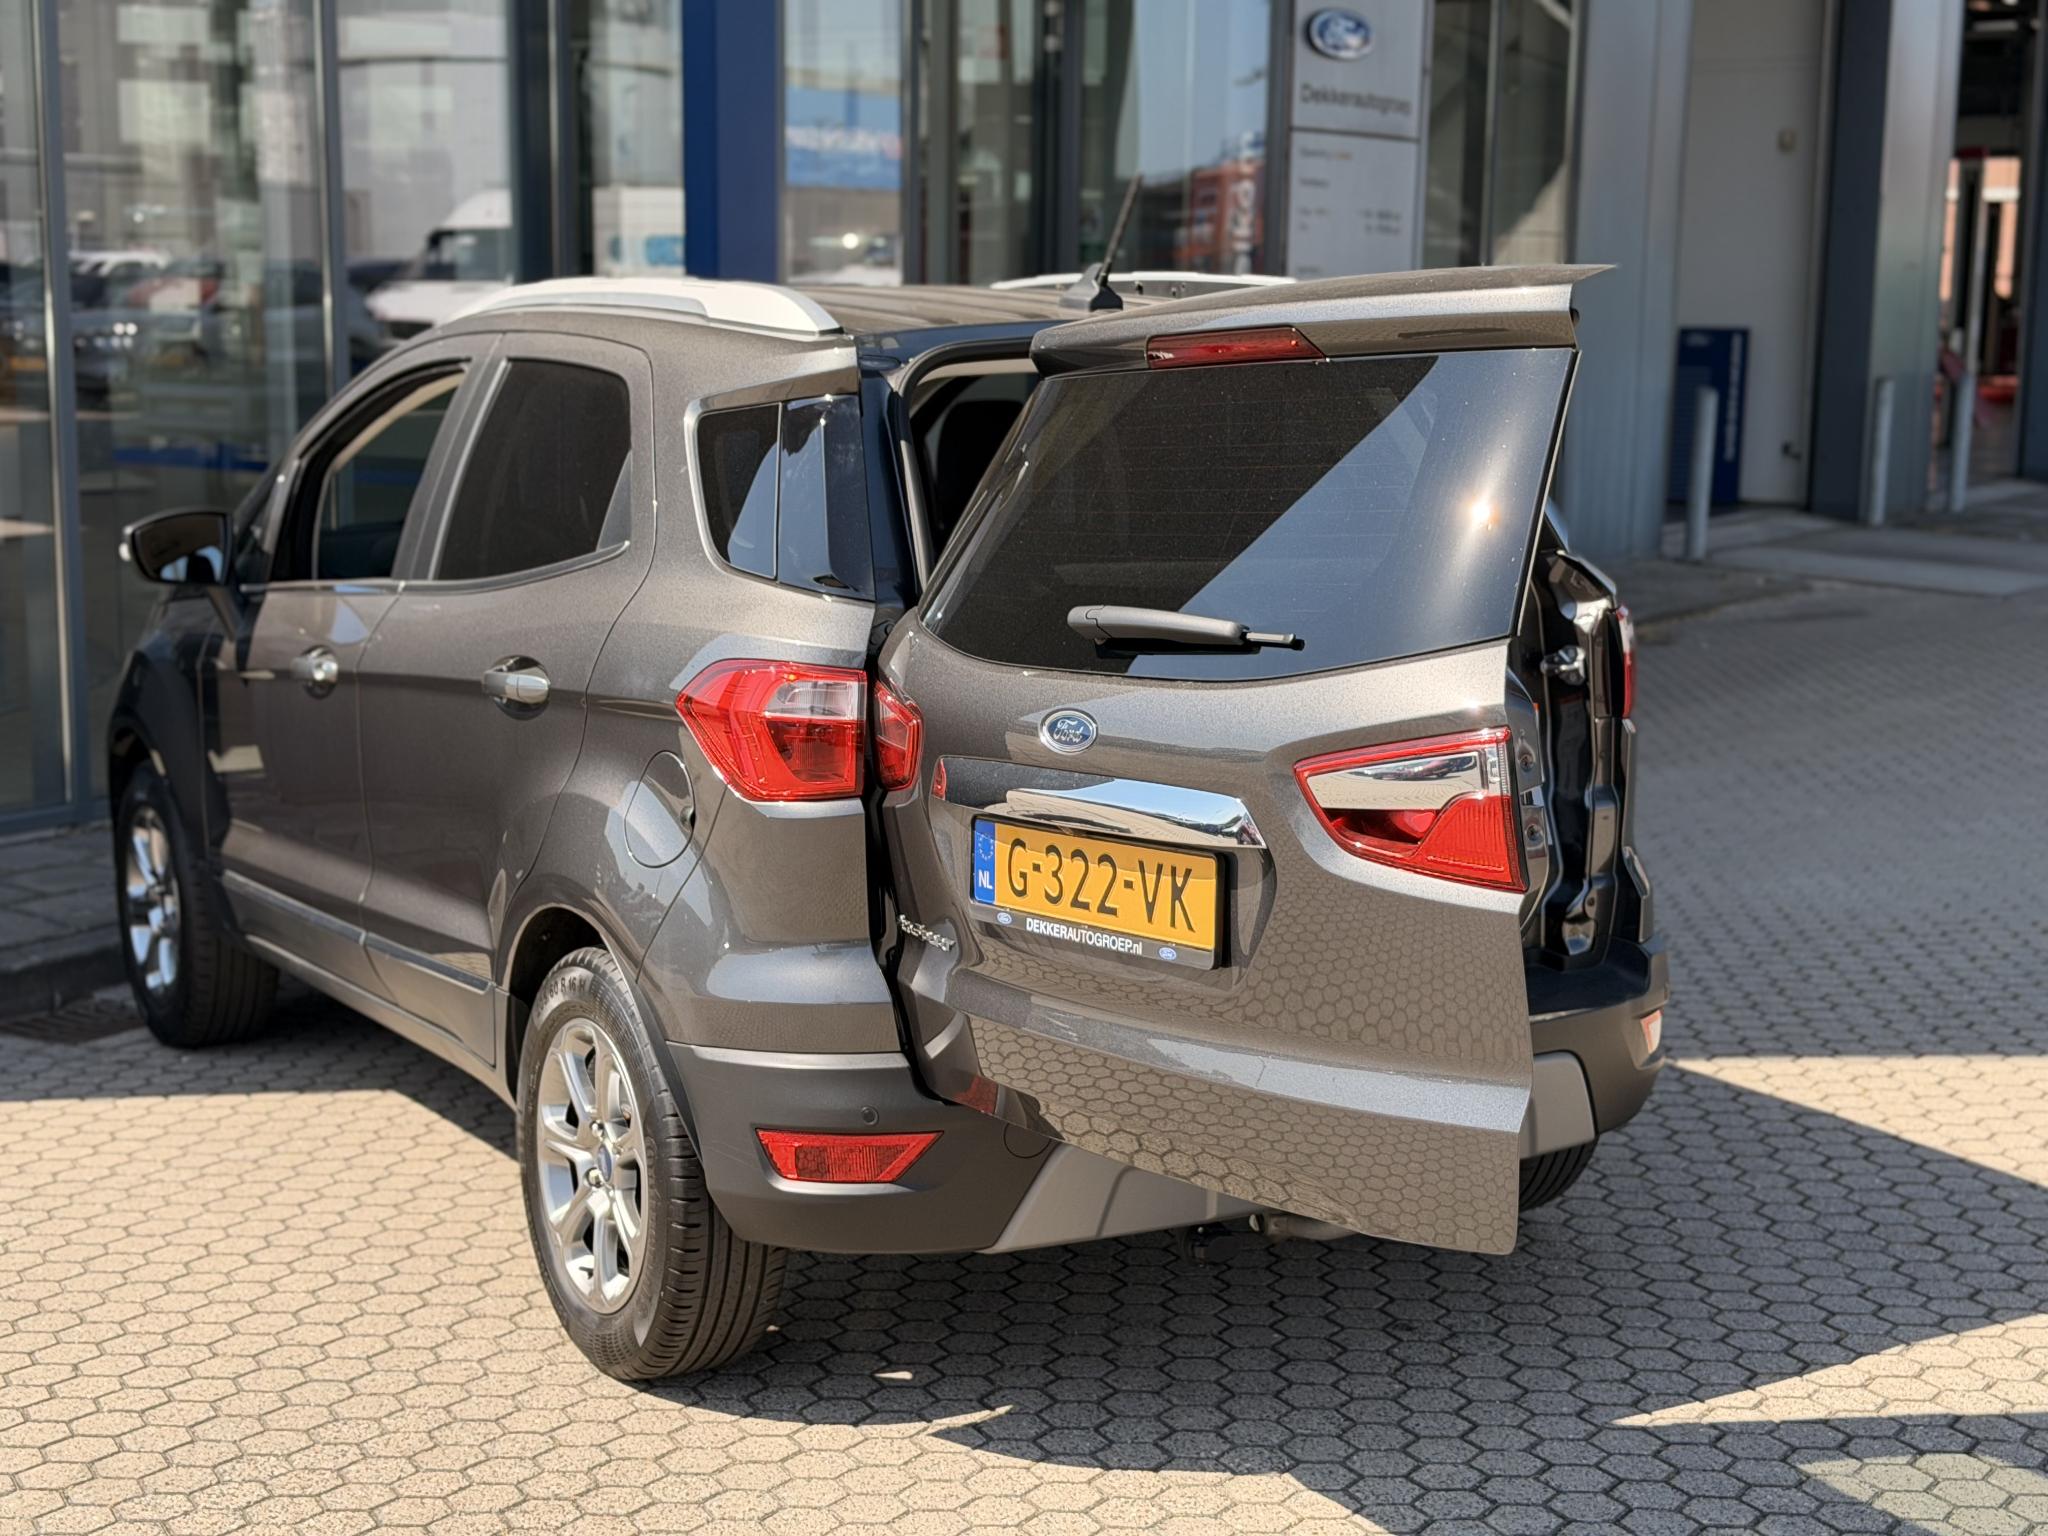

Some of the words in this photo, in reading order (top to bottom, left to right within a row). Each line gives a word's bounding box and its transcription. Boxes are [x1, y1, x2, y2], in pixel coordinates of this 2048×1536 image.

[978, 869, 993, 890] NL
[1007, 838, 1195, 933] G-322-VK
[1025, 917, 1143, 956] DEKKERAUTOGROEP.nl
